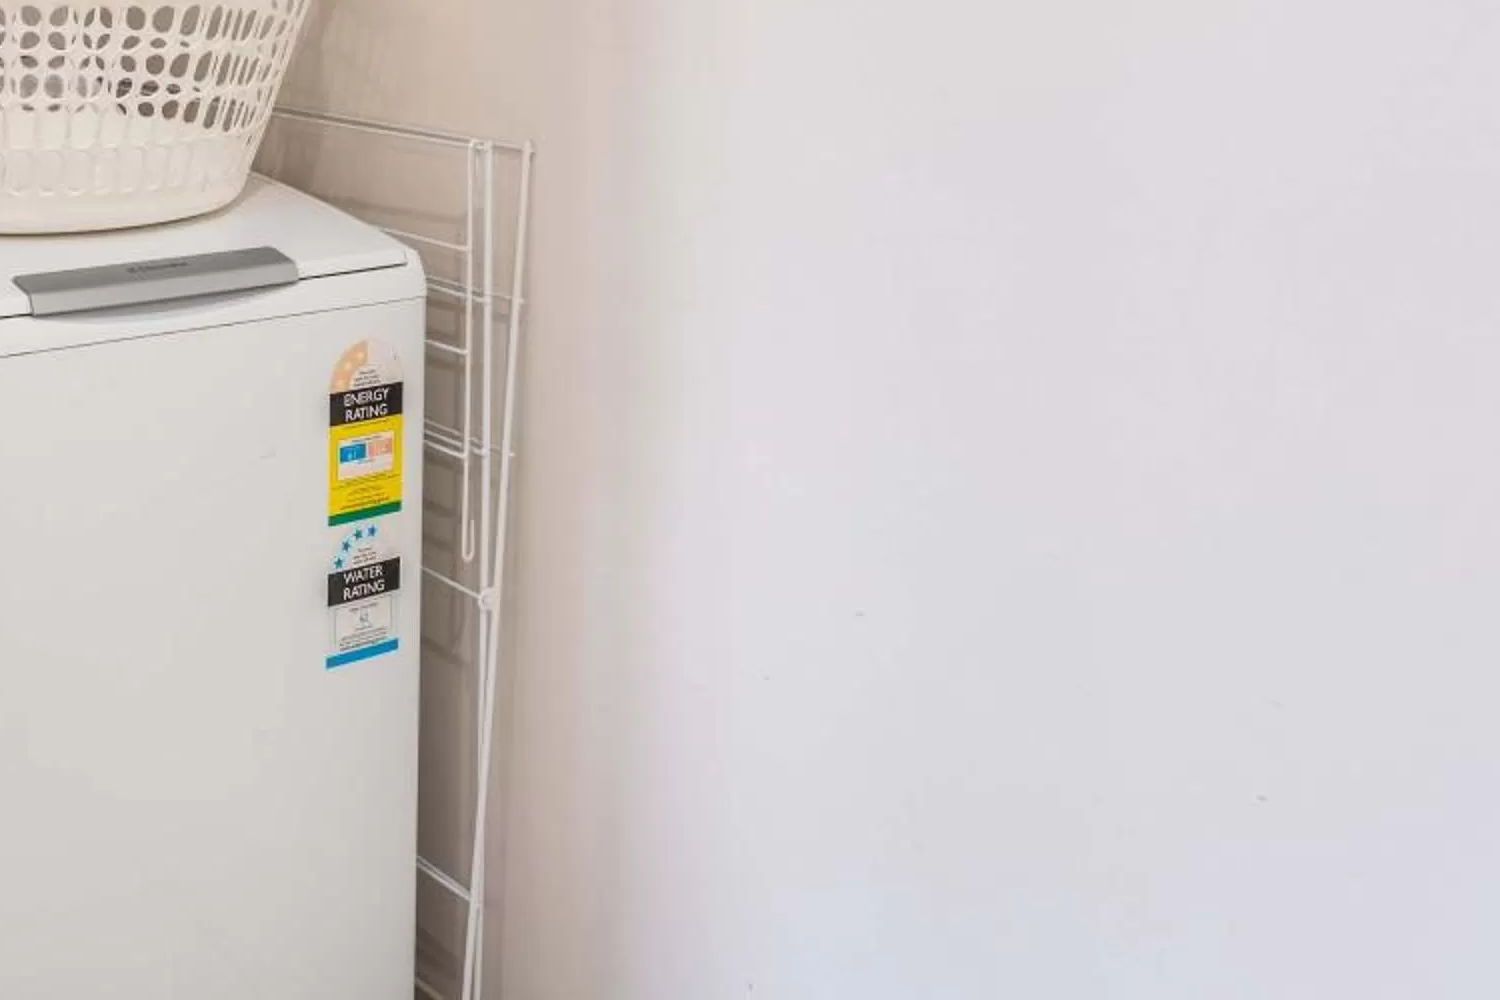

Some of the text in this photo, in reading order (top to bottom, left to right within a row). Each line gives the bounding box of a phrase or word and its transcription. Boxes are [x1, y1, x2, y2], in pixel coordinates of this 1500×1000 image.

[343, 387, 389, 407] ENERGY
[345, 403, 388, 423] RATING
[343, 564, 383, 585] WATER
[343, 580, 385, 601] RATING
